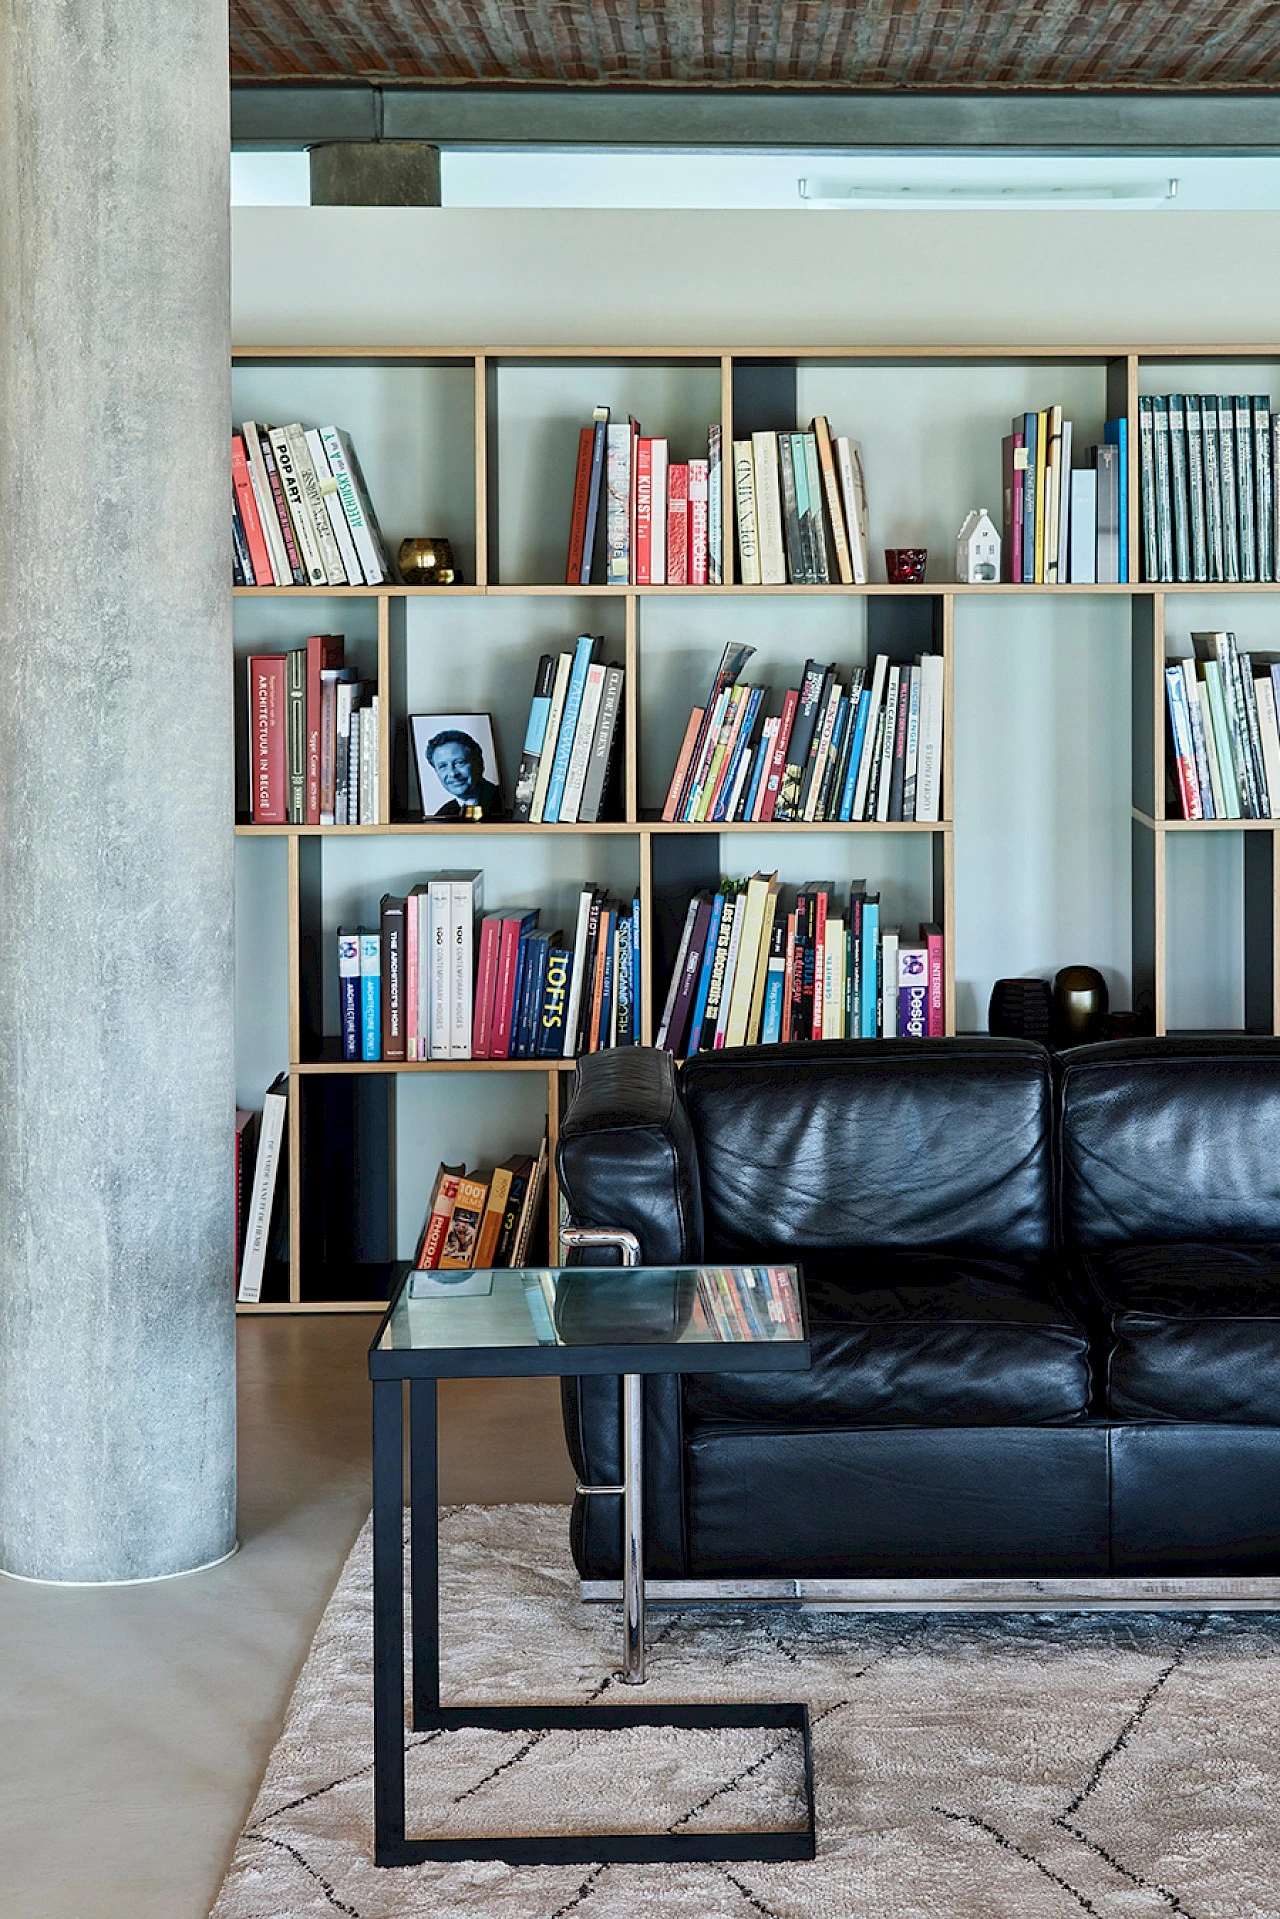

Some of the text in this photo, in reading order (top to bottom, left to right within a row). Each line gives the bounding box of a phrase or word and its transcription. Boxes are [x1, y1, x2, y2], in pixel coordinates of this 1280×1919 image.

[277, 444, 302, 505] POP ART
[637, 475, 649, 521] KUNST
[336, 472, 362, 528] ALECHINSKY
[736, 459, 756, 557] OPEN MIND
[258, 675, 267, 755] ARCHITECTUUR
[554, 679, 583, 782] FALLINGWATER
[259, 759, 267, 770] IN
[589, 905, 600, 936] LOFTS
[718, 923, 731, 947] arts
[722, 903, 735, 922] Les
[435, 947, 443, 1000] CONTEMPORARY
[617, 921, 627, 1033] RECONVERSIONS
[815, 945, 824, 980] PIERRE
[346, 983, 355, 1032] ARCHITECTURE
[365, 981, 375, 1029] ARCHITECTURE
[540, 956, 569, 1028] LOFTS
[458, 1197, 483, 1207] FILMS
[460, 1183, 486, 1199] 1001
[426, 1217, 444, 1255] PHOTO
[504, 1213, 514, 1230] 3
